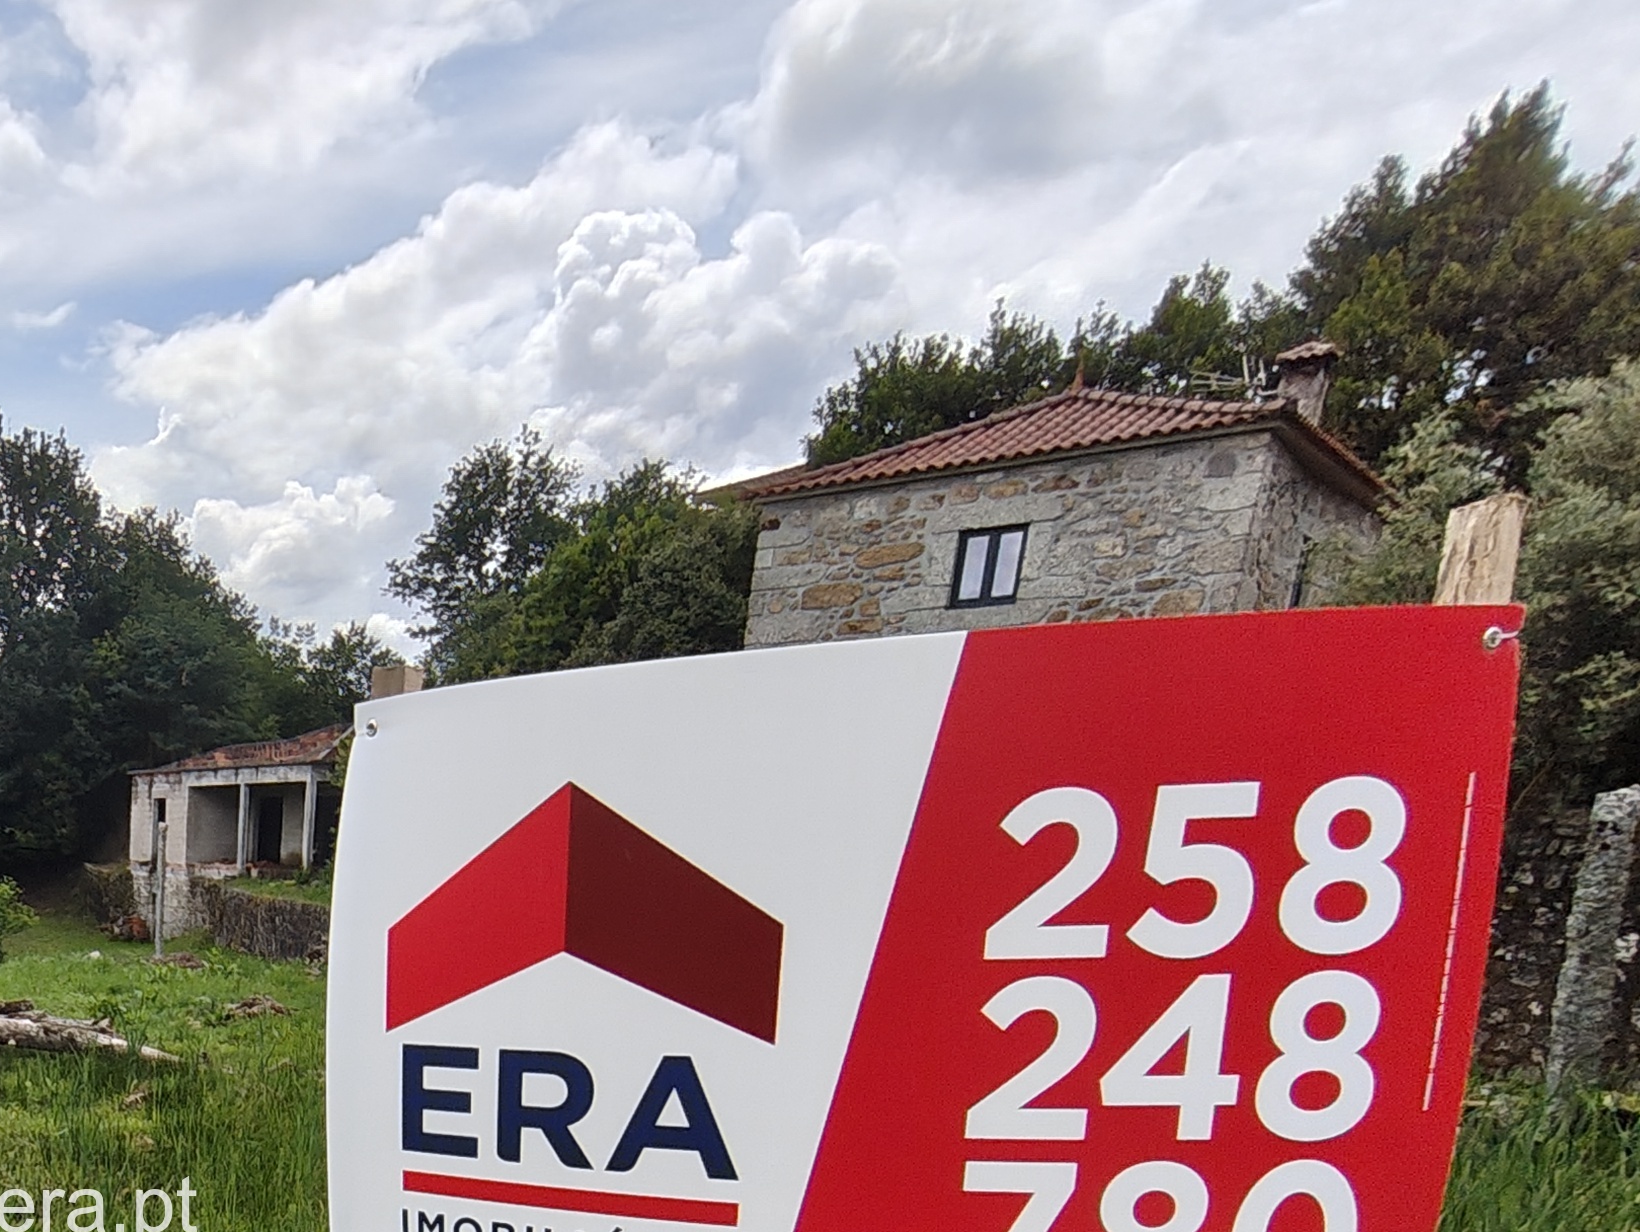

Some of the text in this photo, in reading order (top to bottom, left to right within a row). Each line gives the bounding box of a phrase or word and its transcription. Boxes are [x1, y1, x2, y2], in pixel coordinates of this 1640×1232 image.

[982, 775, 1407, 961] 258
[402, 1043, 739, 1181] ERA
[963, 969, 1381, 1142] 248
